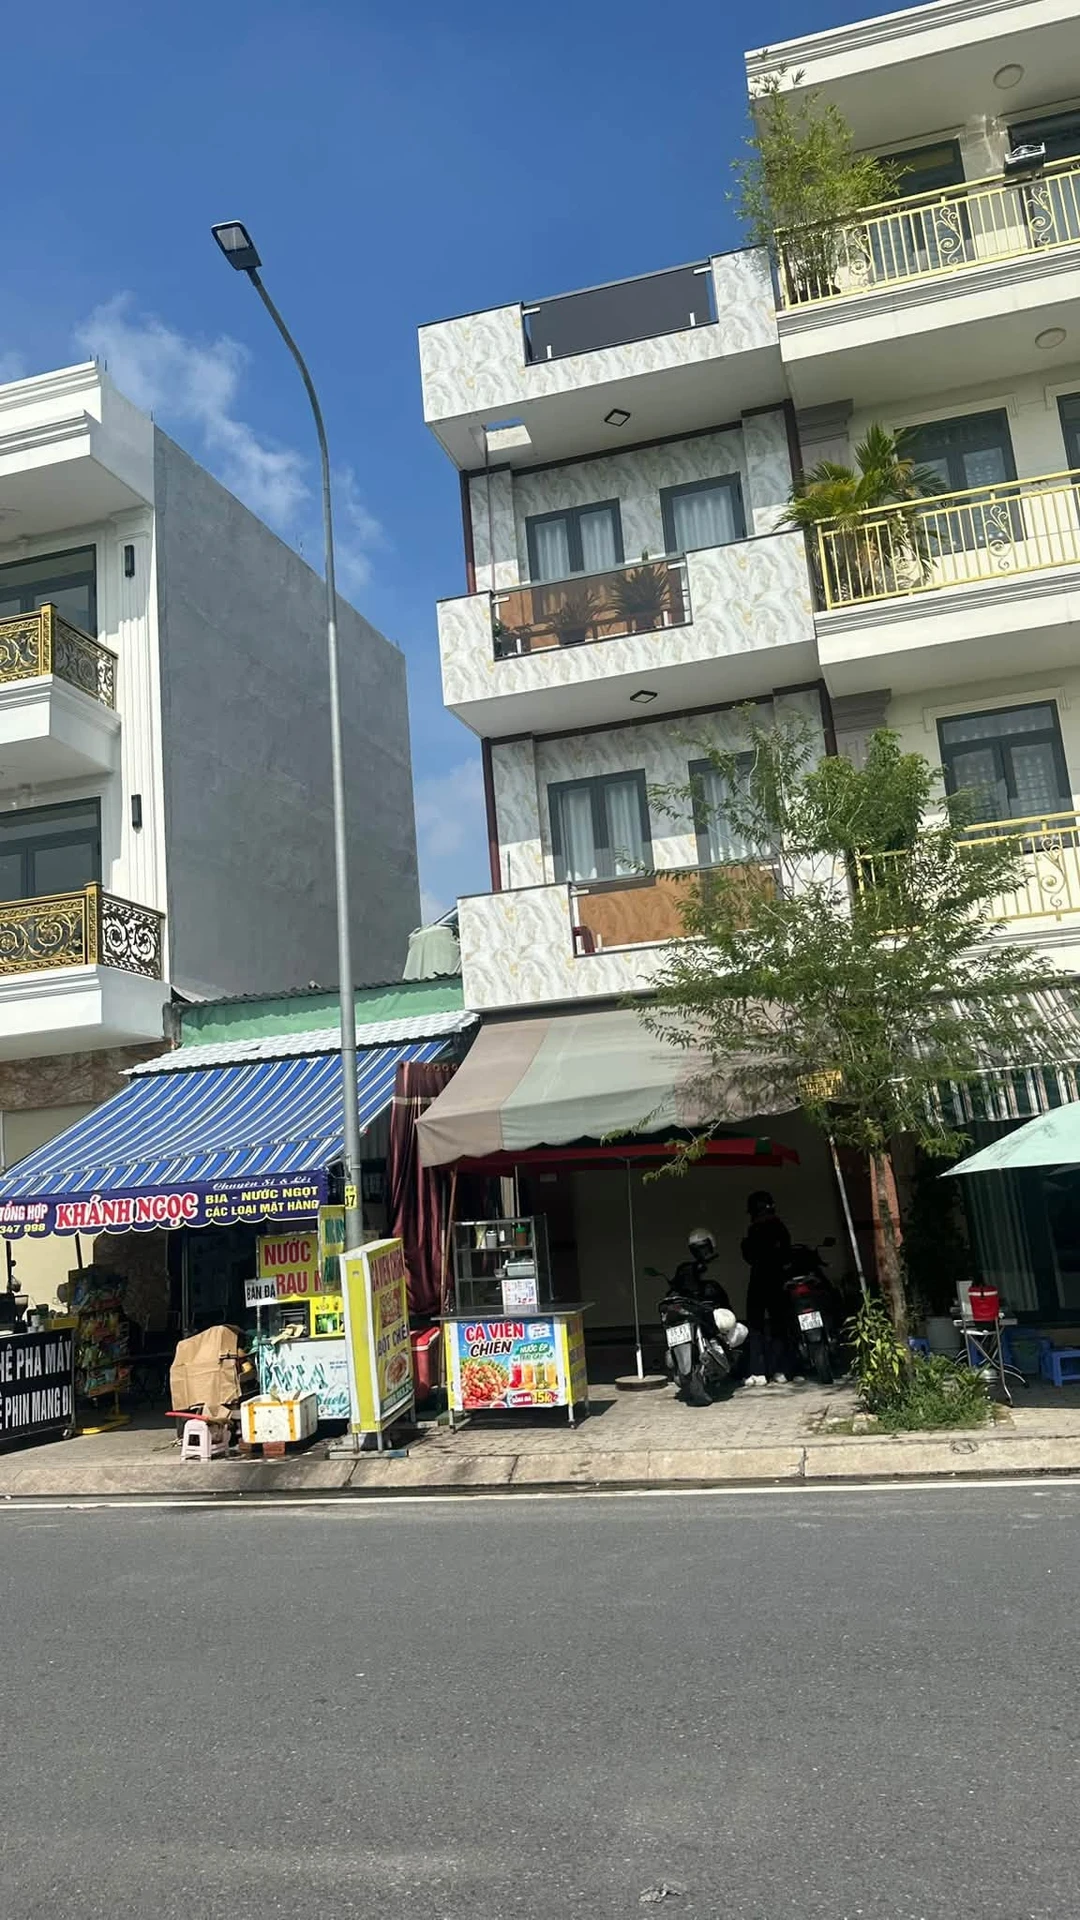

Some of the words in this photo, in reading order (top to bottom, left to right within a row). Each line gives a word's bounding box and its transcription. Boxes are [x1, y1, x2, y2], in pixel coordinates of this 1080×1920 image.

[205, 1193, 228, 1204] BIA
[241, 1188, 279, 1201] NƯỚC
[282, 1186, 319, 1198] NGỌT
[27, 1203, 48, 1223] HỢP
[56, 1194, 131, 1229] KHÁNH
[135, 1192, 199, 1227] NGỌC
[205, 1204, 228, 1217] CÁC
[231, 1204, 257, 1217] LOẠI
[260, 1201, 285, 1214] MẶT
[287, 1199, 320, 1211] HÀNG
[24, 1223, 46, 1233] 998
[264, 1237, 311, 1266] NƯỚC
[276, 1271, 308, 1295] RAU
[488, 1320, 525, 1340] VIÊN
[16, 1345, 42, 1380] PHA
[45, 1335, 71, 1375] MÁY
[470, 1338, 513, 1358] CHIÊN
[5, 1393, 30, 1429] PHIN
[31, 1387, 61, 1423] MANG
[62, 1384, 72, 1416] ĐI
